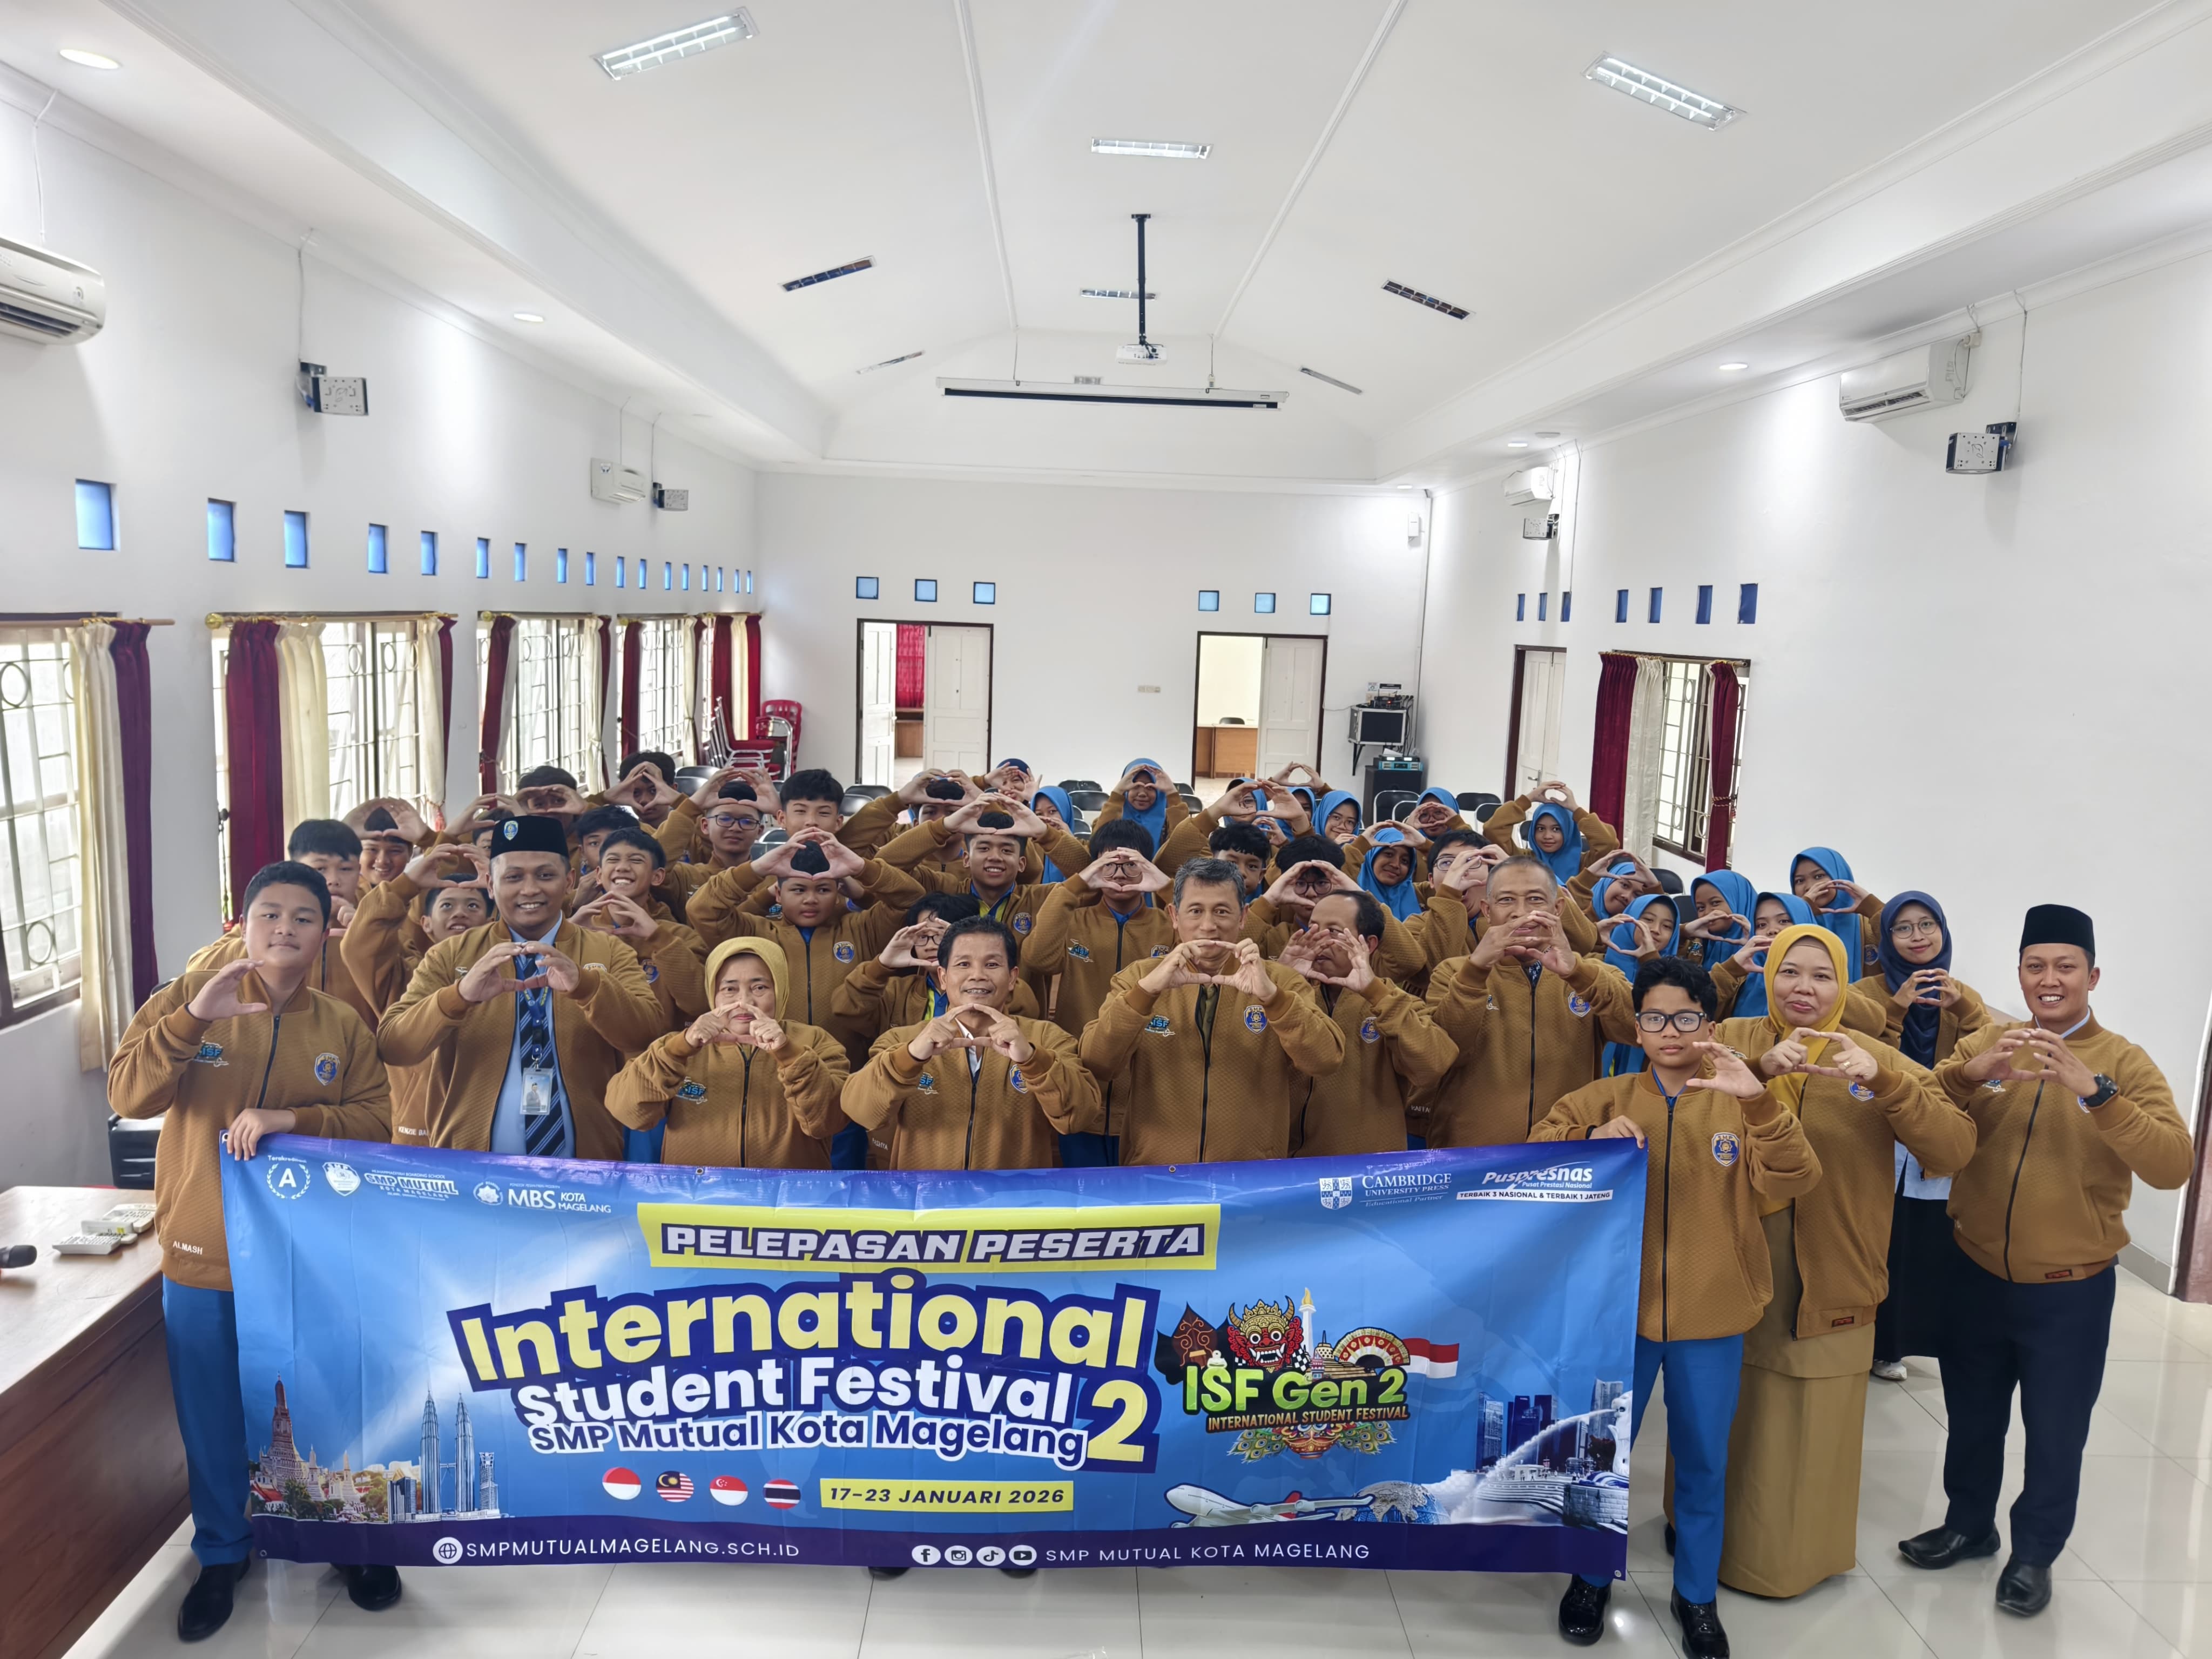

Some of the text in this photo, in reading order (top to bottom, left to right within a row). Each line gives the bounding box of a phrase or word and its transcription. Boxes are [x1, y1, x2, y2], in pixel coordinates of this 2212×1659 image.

[1077, 947, 1089, 956] ISF
[1153, 1020, 1169, 1028] ISF
[202, 1048, 221, 1056] ISF
[920, 1076, 933, 1084] SF
[687, 1087, 705, 1095] ISF
[398, 1126, 416, 1136] KENZIE
[278, 1168, 296, 1188] A
[1362, 1173, 1452, 1189] CAMBRIDGE
[1482, 1168, 1593, 1185] Puspresnas
[365, 1174, 397, 1186] SMP
[399, 1178, 458, 1195] MUTUAL
[1365, 1187, 1421, 1197] UNIVERSITY
[508, 1189, 556, 1210] MBS
[561, 1192, 586, 1202] KOTA
[1365, 1197, 1412, 1207] Educational
[1584, 1192, 1610, 1200] JATENG
[558, 1202, 611, 1213] MAGELANG
[172, 1240, 203, 1255] ALMASH
[667, 1226, 1199, 1260] PELEPASAN PESERTA
[461, 1274, 1147, 1381] International
[1186, 1365, 1405, 1412] ISF Gen 2
[517, 1354, 1148, 1462] Student Festival 2
[1208, 1405, 1409, 1431] INTERNATIONAL STUDENT FESTIVAL
[531, 1414, 1084, 1467] SMP Mutual Kota Magelang
[898, 1489, 1002, 1504] JANUARI
[1008, 1489, 1064, 1504] 2026
[466, 1537, 799, 1557] SMPMUTUALMAGELANG.SCH.ID
[1046, 1543, 1370, 1561] SMP MUTUAL KOTA MAGELANG
